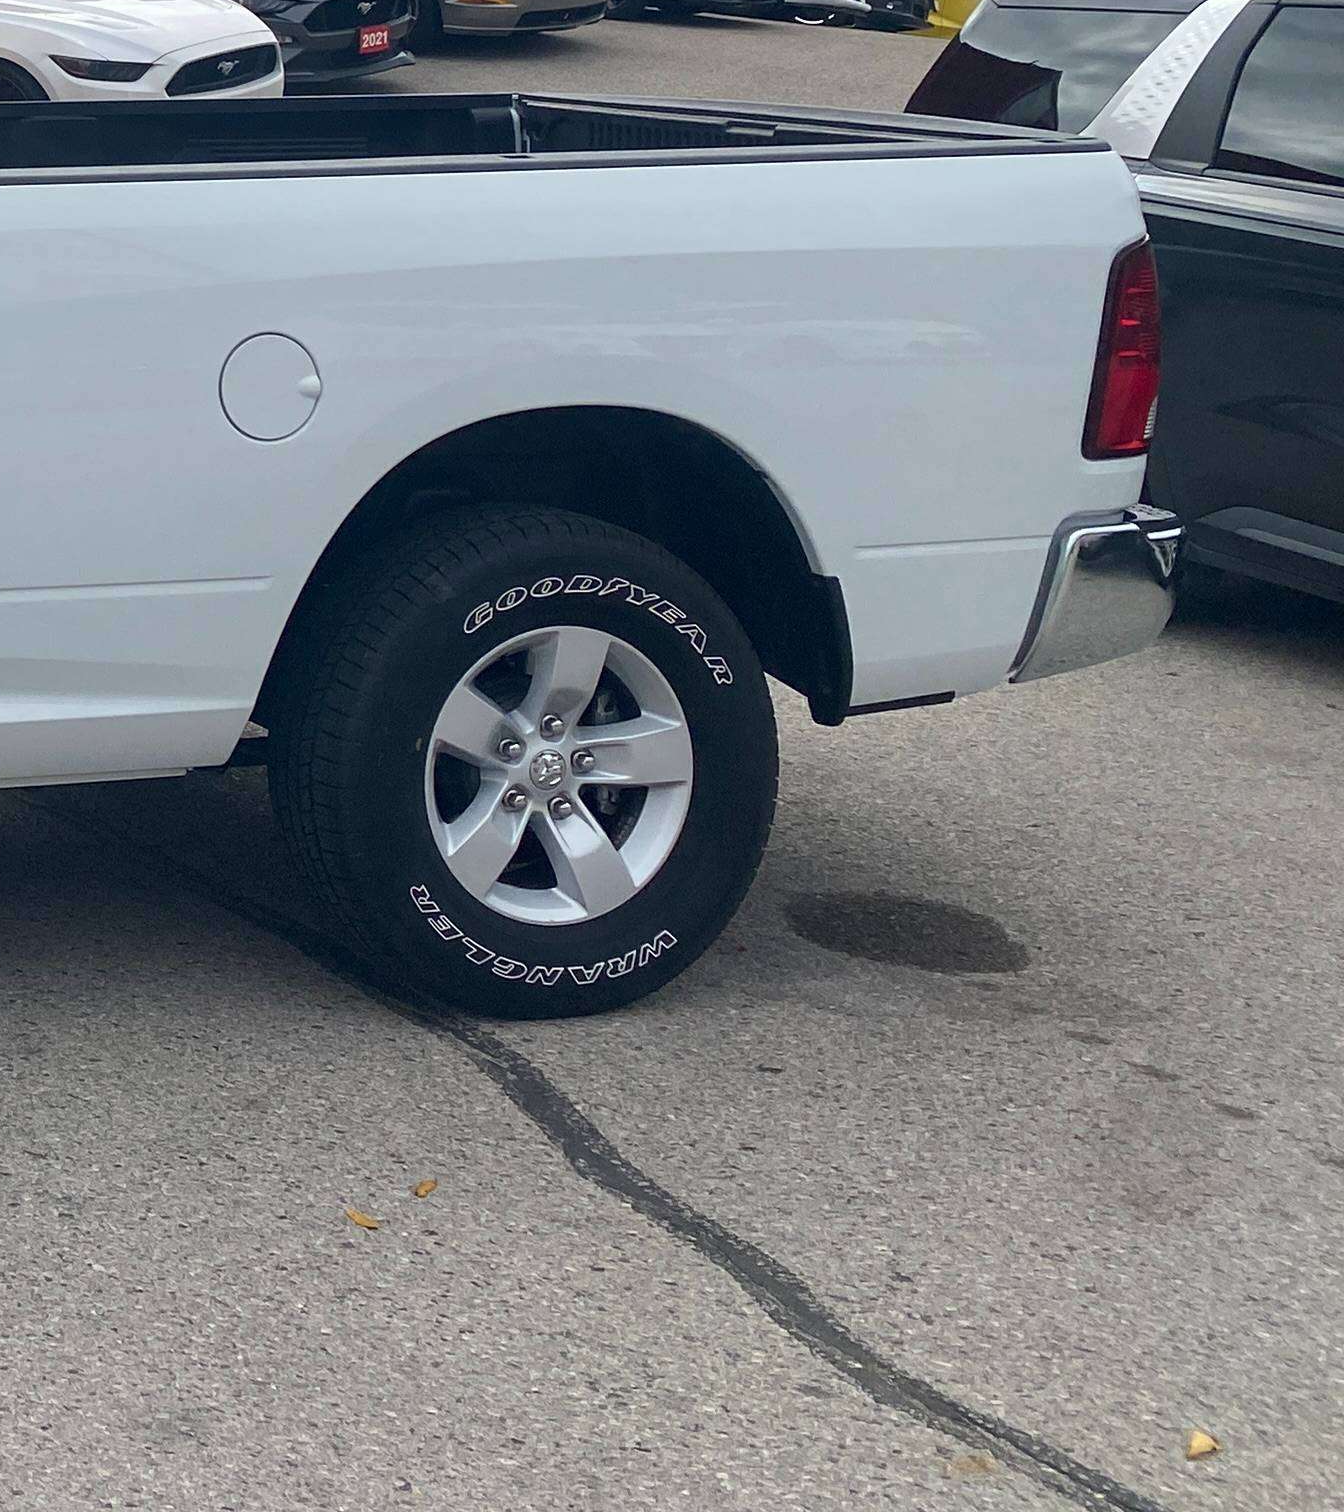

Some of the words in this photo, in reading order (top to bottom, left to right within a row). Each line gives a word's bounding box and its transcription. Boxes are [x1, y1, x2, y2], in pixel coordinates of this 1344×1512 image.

[362, 31, 388, 48] 2021
[464, 575, 734, 684] GOODYEAR
[410, 884, 678, 986] WRANGLER
